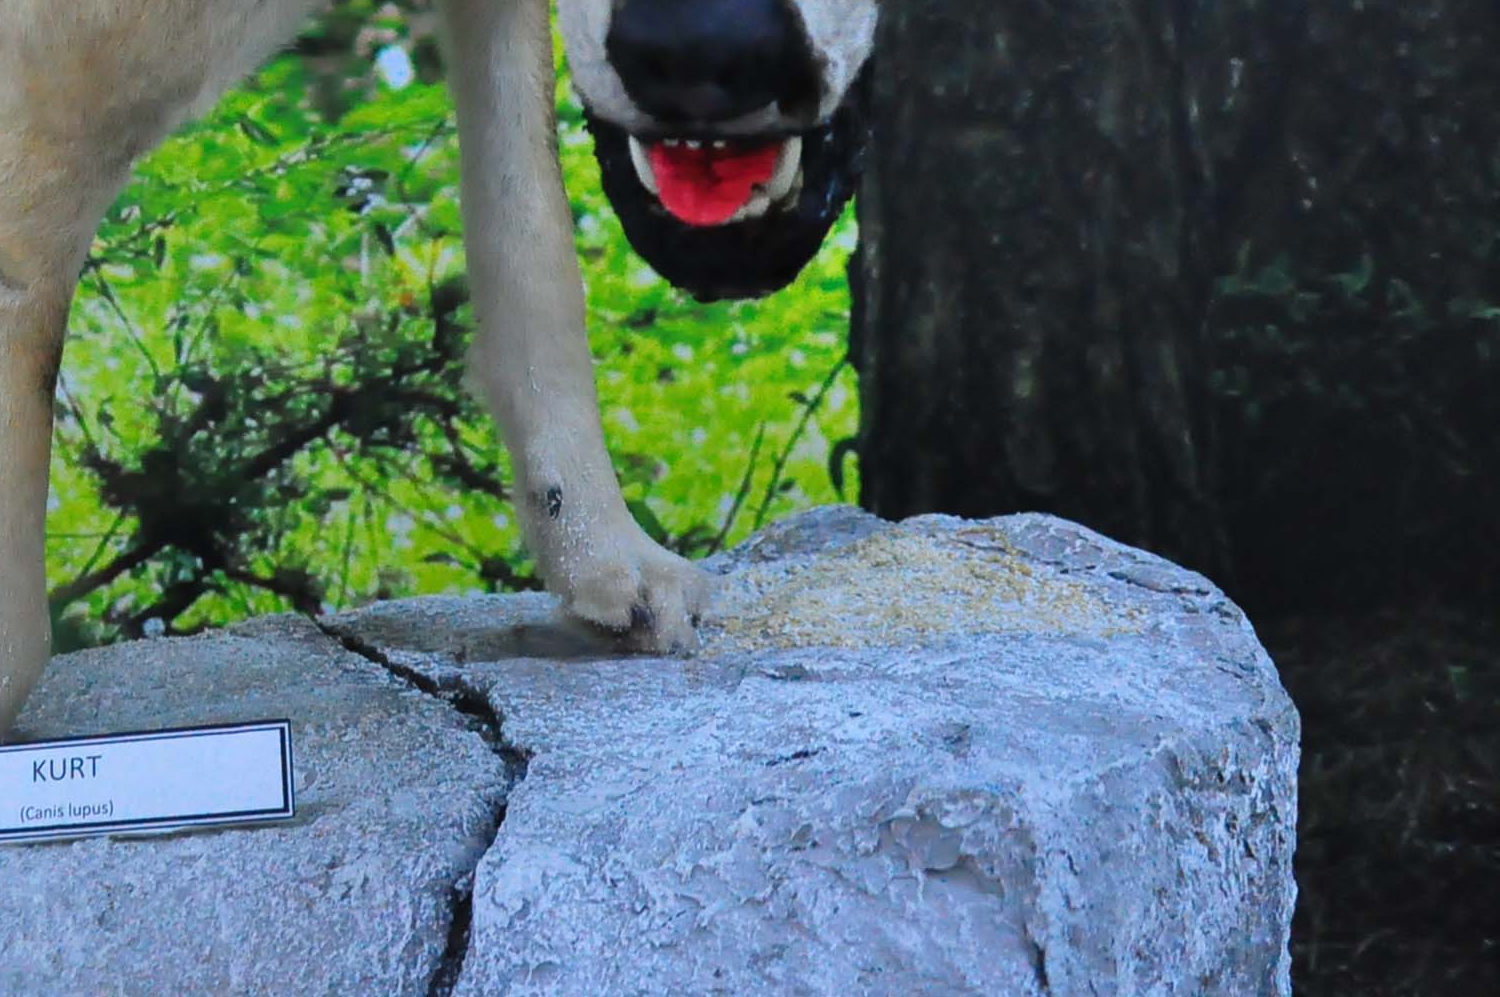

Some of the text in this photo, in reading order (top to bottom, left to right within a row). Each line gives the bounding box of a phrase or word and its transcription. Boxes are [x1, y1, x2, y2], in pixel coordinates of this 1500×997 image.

[32, 755, 102, 782] KURT
[20, 800, 114, 823] (Canis lupus)
